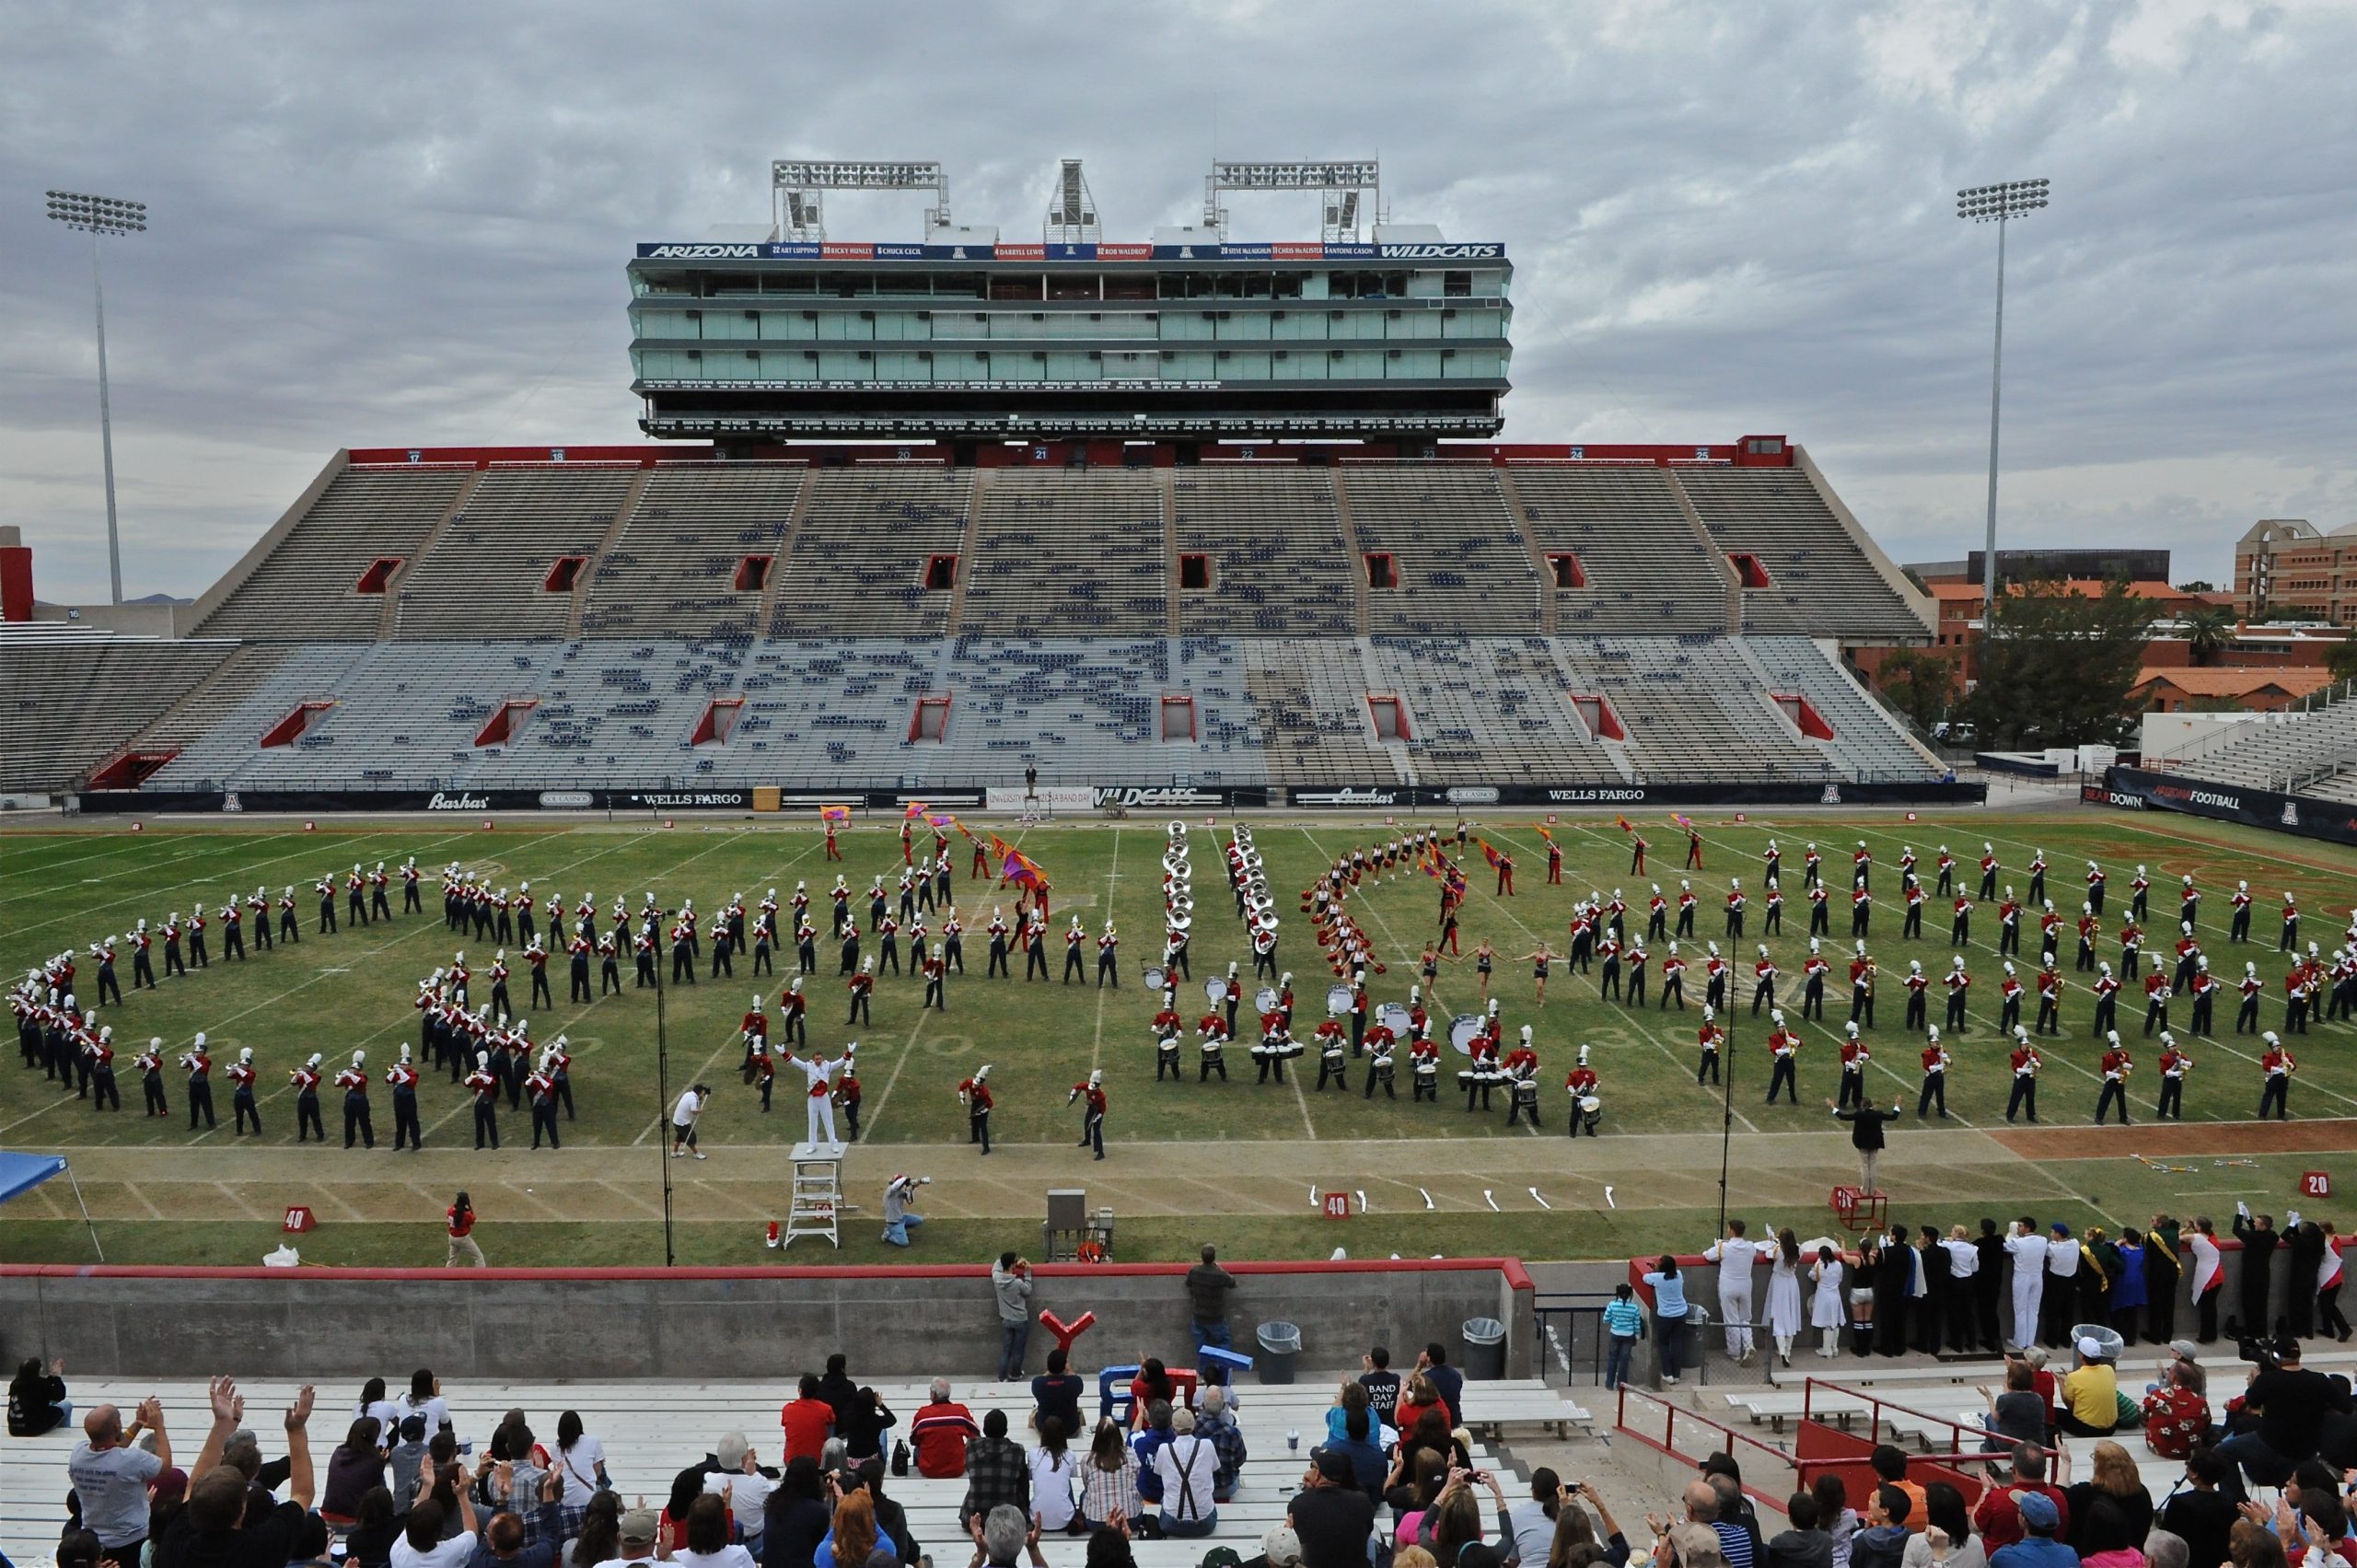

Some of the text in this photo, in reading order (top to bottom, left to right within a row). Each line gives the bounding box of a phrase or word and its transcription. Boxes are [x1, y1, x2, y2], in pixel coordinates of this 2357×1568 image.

[649, 245, 758, 257] ARIZONA
[830, 246, 848, 254] RICKY
[882, 247, 903, 255] CHUCK
[904, 247, 921, 255] CECIL
[1381, 245, 1498, 258] WILDCATS
[410, 455, 419, 463] 17
[552, 453, 563, 461] 18
[715, 452, 726, 460] 19
[898, 451, 910, 459] 20
[1036, 450, 1046, 459] 21
[1423, 450, 1434, 459] 23
[1571, 451, 1583, 459] 24
[1697, 451, 1708, 459] 25
[69, 610, 79, 618] 16
[644, 794, 741, 804] WELLS FARGO
[989, 794, 1021, 803] UNIVERSITY
[1060, 794, 1077, 802] BAND
[1078, 794, 1090, 802] DAY
[1549, 790, 1643, 800] WELLS FARGO
[427, 792, 489, 809] Bashas'
[2308, 1176, 2328, 1193] 20
[1328, 1197, 1344, 1214] 40
[285, 1210, 304, 1229] 40
[1369, 1385, 1396, 1393] BAND
[1373, 1393, 1392, 1401] DAY
[1370, 1400, 1395, 1410] STAFF
